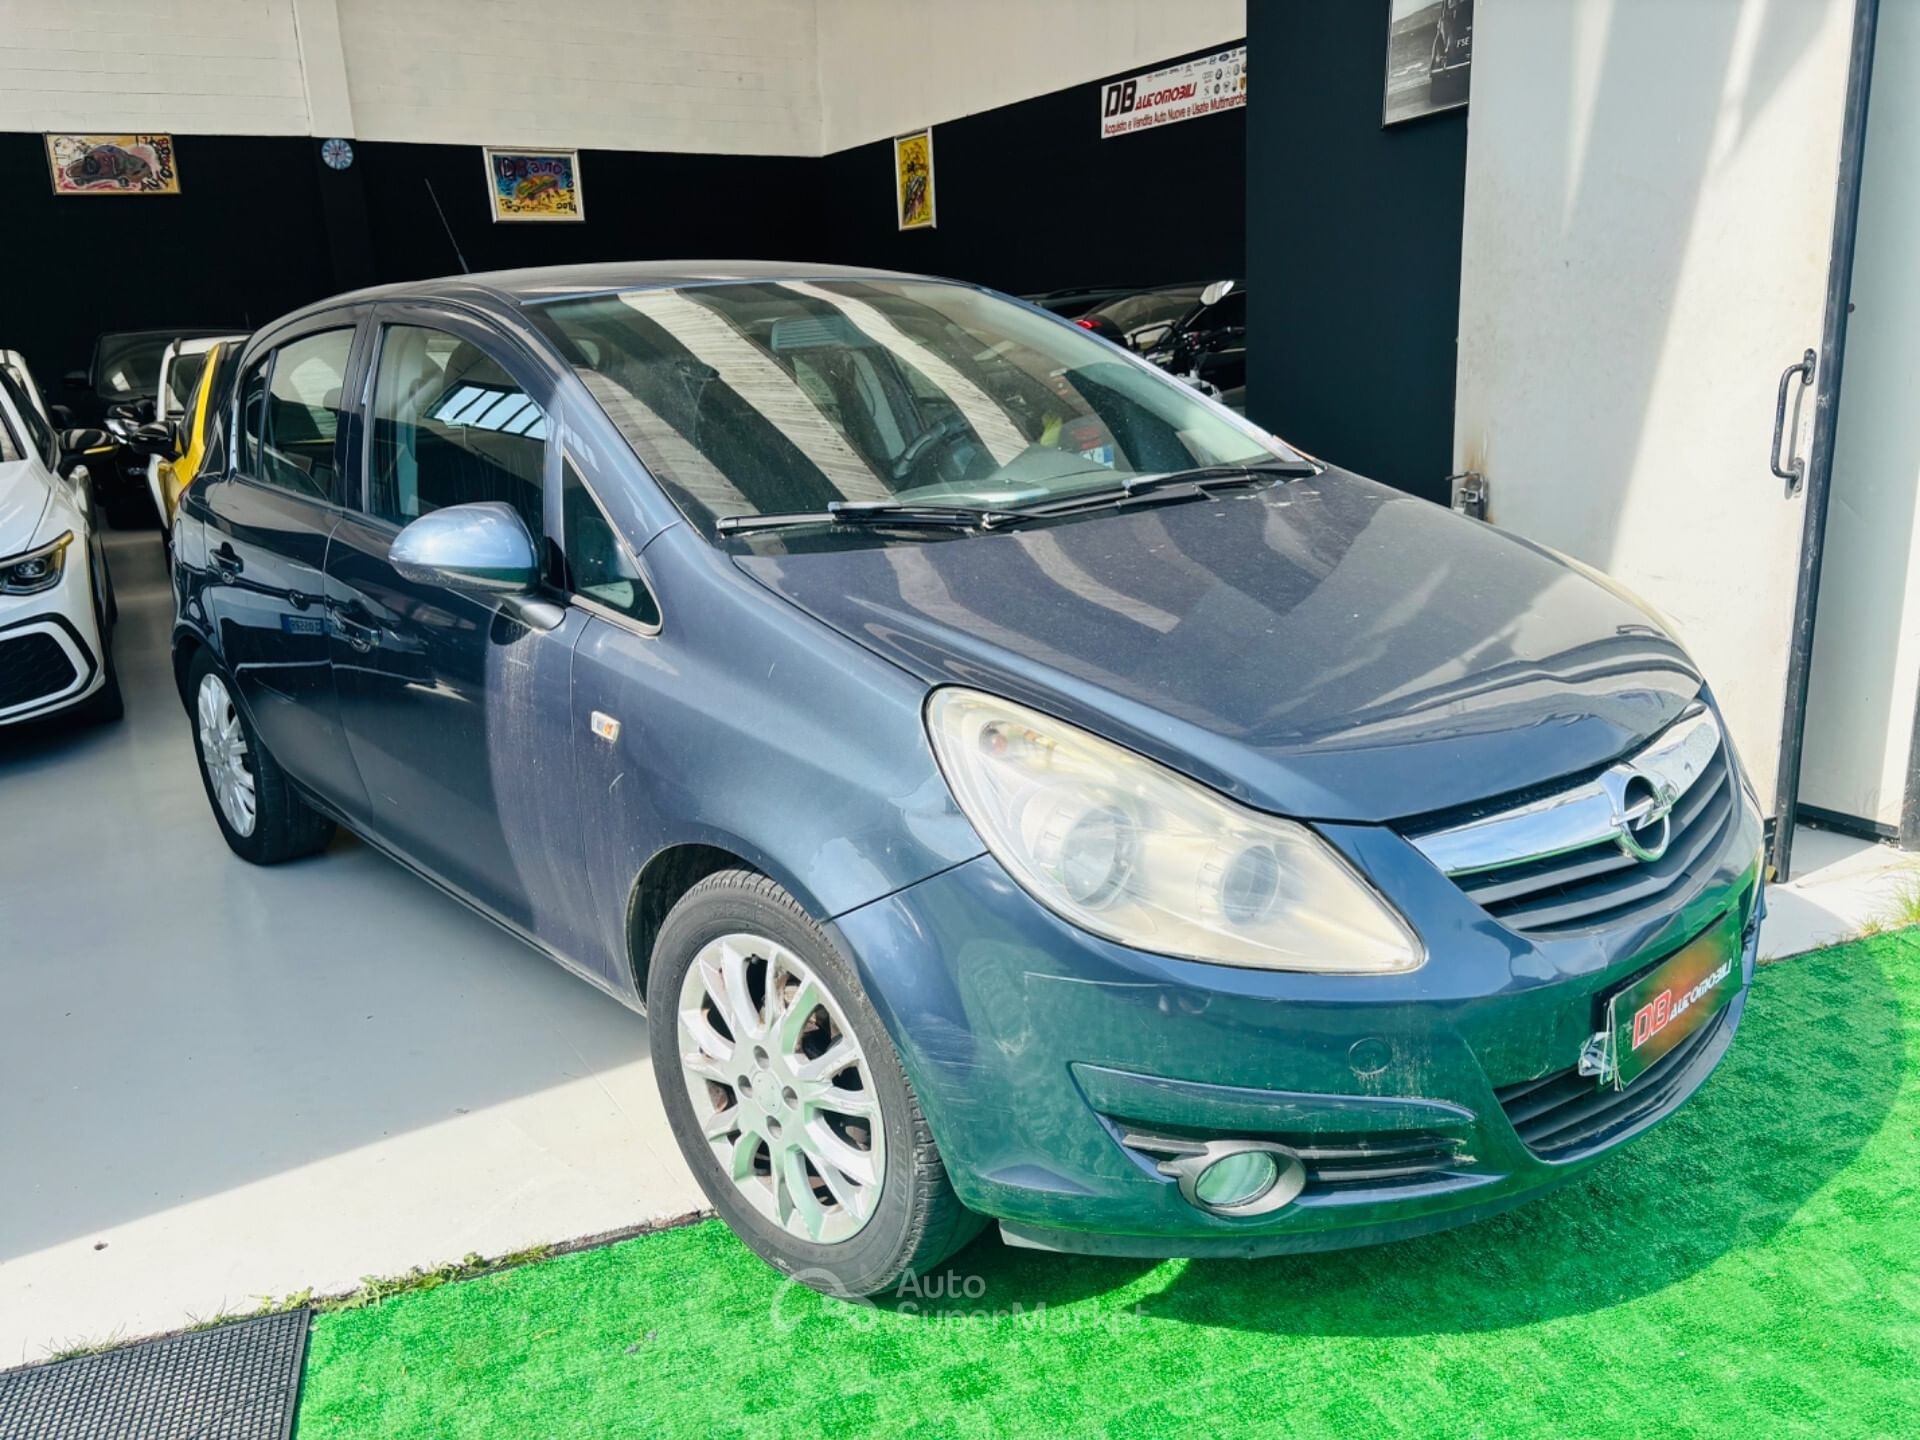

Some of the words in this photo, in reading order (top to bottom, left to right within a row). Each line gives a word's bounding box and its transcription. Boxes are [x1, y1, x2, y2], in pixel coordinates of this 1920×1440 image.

[1104, 79, 1137, 118] DB
[1104, 120, 1127, 135] Acquisto
[1133, 115, 1153, 127] Vendita
[1154, 112, 1167, 123] Auto
[1168, 108, 1186, 121] Nuove
[1192, 102, 1210, 115] Usate
[1632, 989, 1672, 1051] DB
